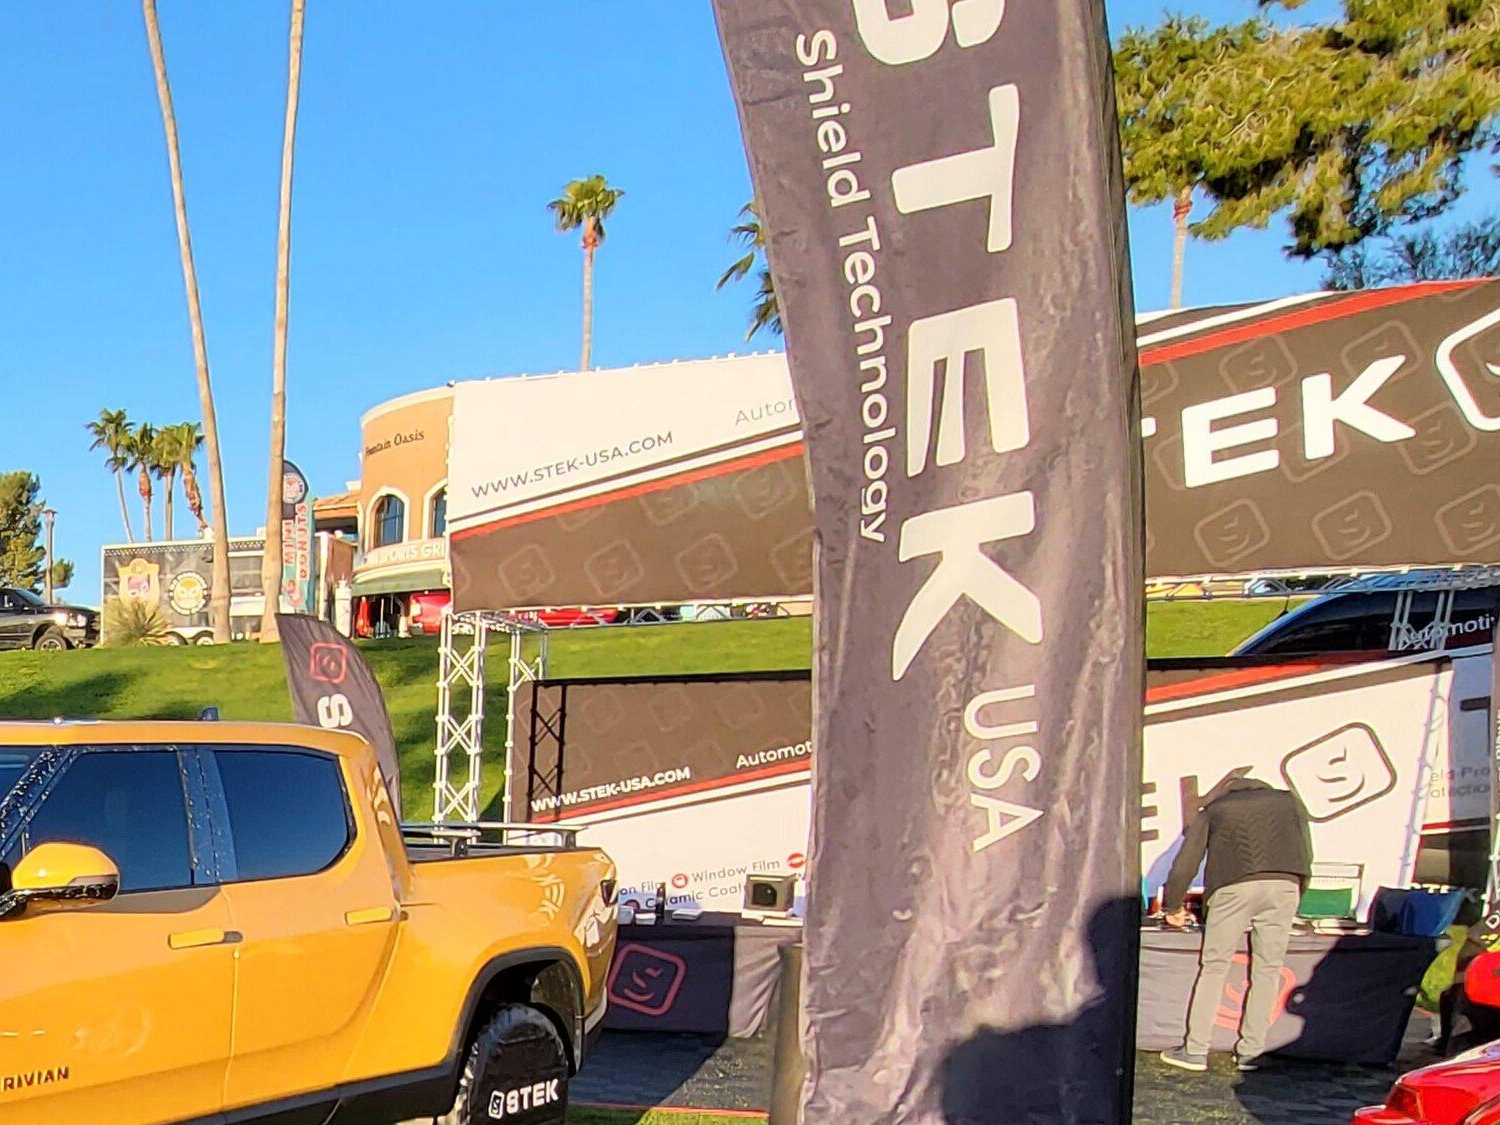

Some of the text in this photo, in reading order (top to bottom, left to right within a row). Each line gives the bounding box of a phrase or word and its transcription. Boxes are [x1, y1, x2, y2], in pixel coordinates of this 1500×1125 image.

[795, 29, 897, 543] Shield Technology
[1141, 354, 1417, 488] EK
[471, 431, 673, 498] WWW.STEK-USA.COM
[531, 767, 691, 813] WWW.STEK-USA.COM
[964, 684, 1045, 852] USA
[691, 865, 748, 883] Window
[752, 859, 781, 873] Film
[1, 1066, 70, 1092] RIVIAN
[506, 1078, 560, 1115] STEK
